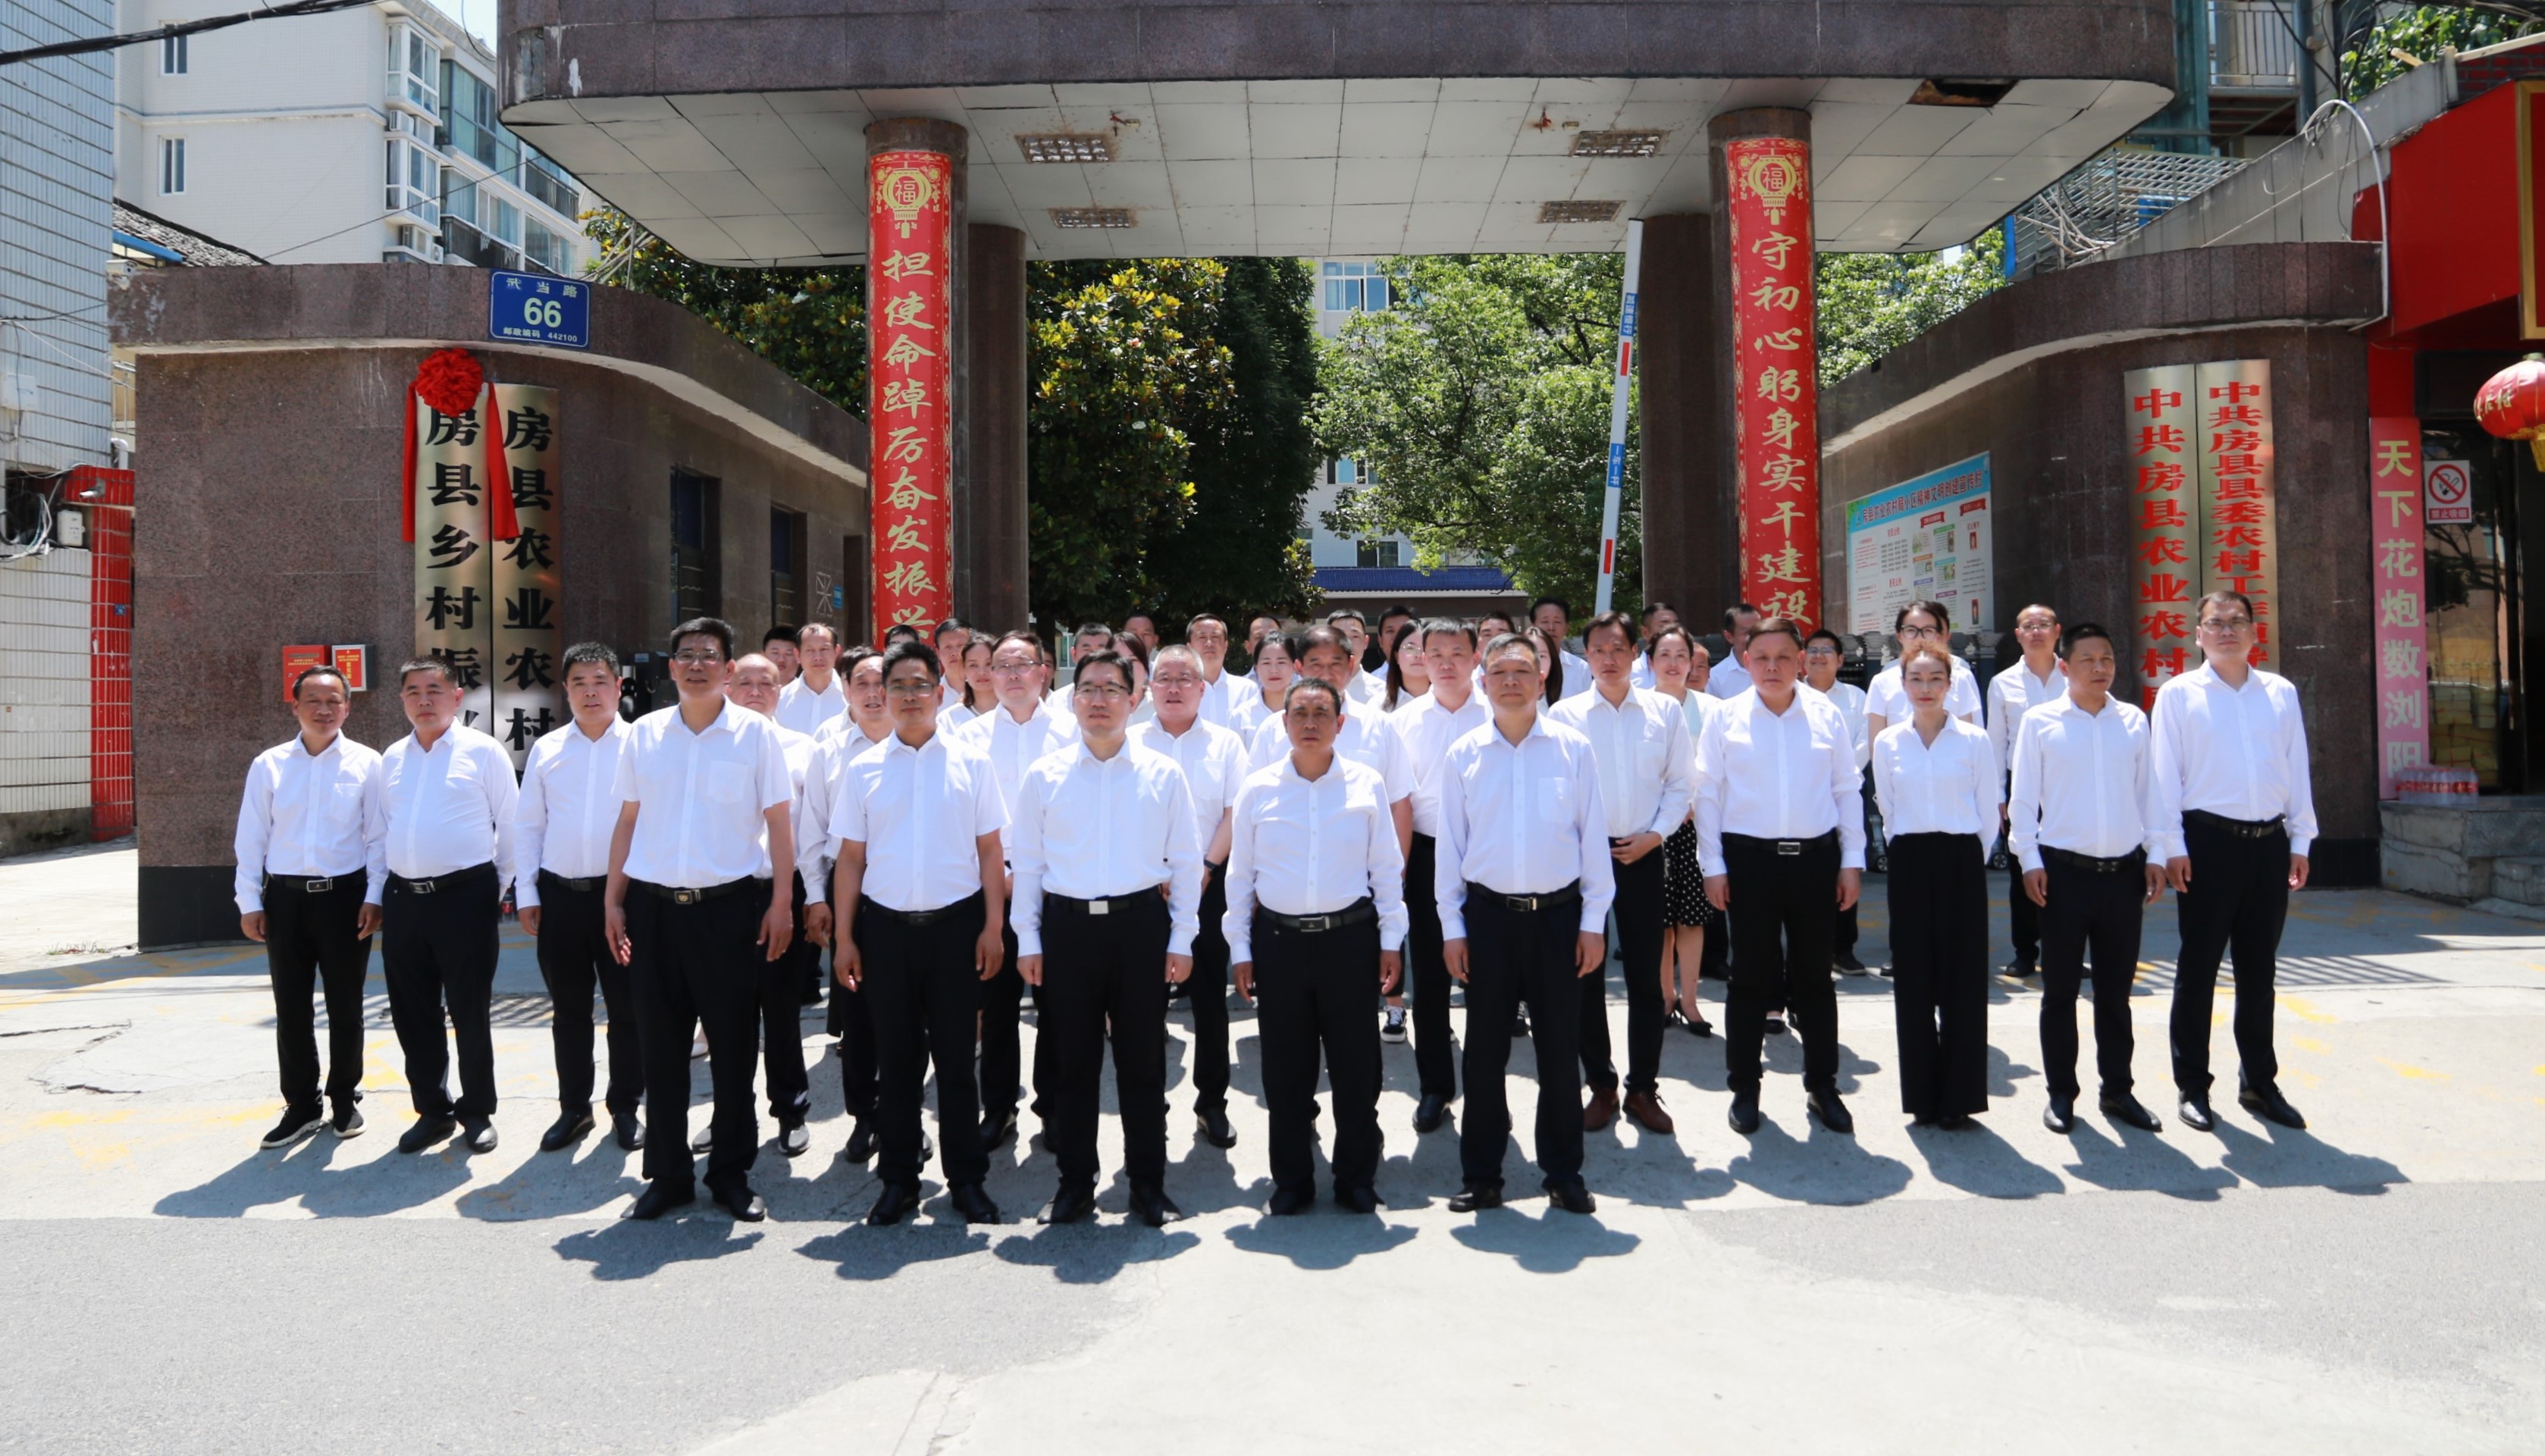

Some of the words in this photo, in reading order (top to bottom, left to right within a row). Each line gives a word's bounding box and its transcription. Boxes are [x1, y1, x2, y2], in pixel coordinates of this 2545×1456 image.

[524, 297, 562, 327] 66
[895, 179, 917, 202] 福
[1761, 167, 1784, 189] 福
[503, 327, 541, 338] 邮政编码
[547, 332, 578, 342] 442100
[882, 249, 936, 639] 担使命踔厉奋发振兴
[1748, 230, 1812, 625] 守初心躬身实干建设
[502, 405, 556, 785] 房县农业农村
[2207, 381, 2269, 667] 中共房县县委农村工
[2376, 440, 2422, 778] 天下花炮数浏阳
